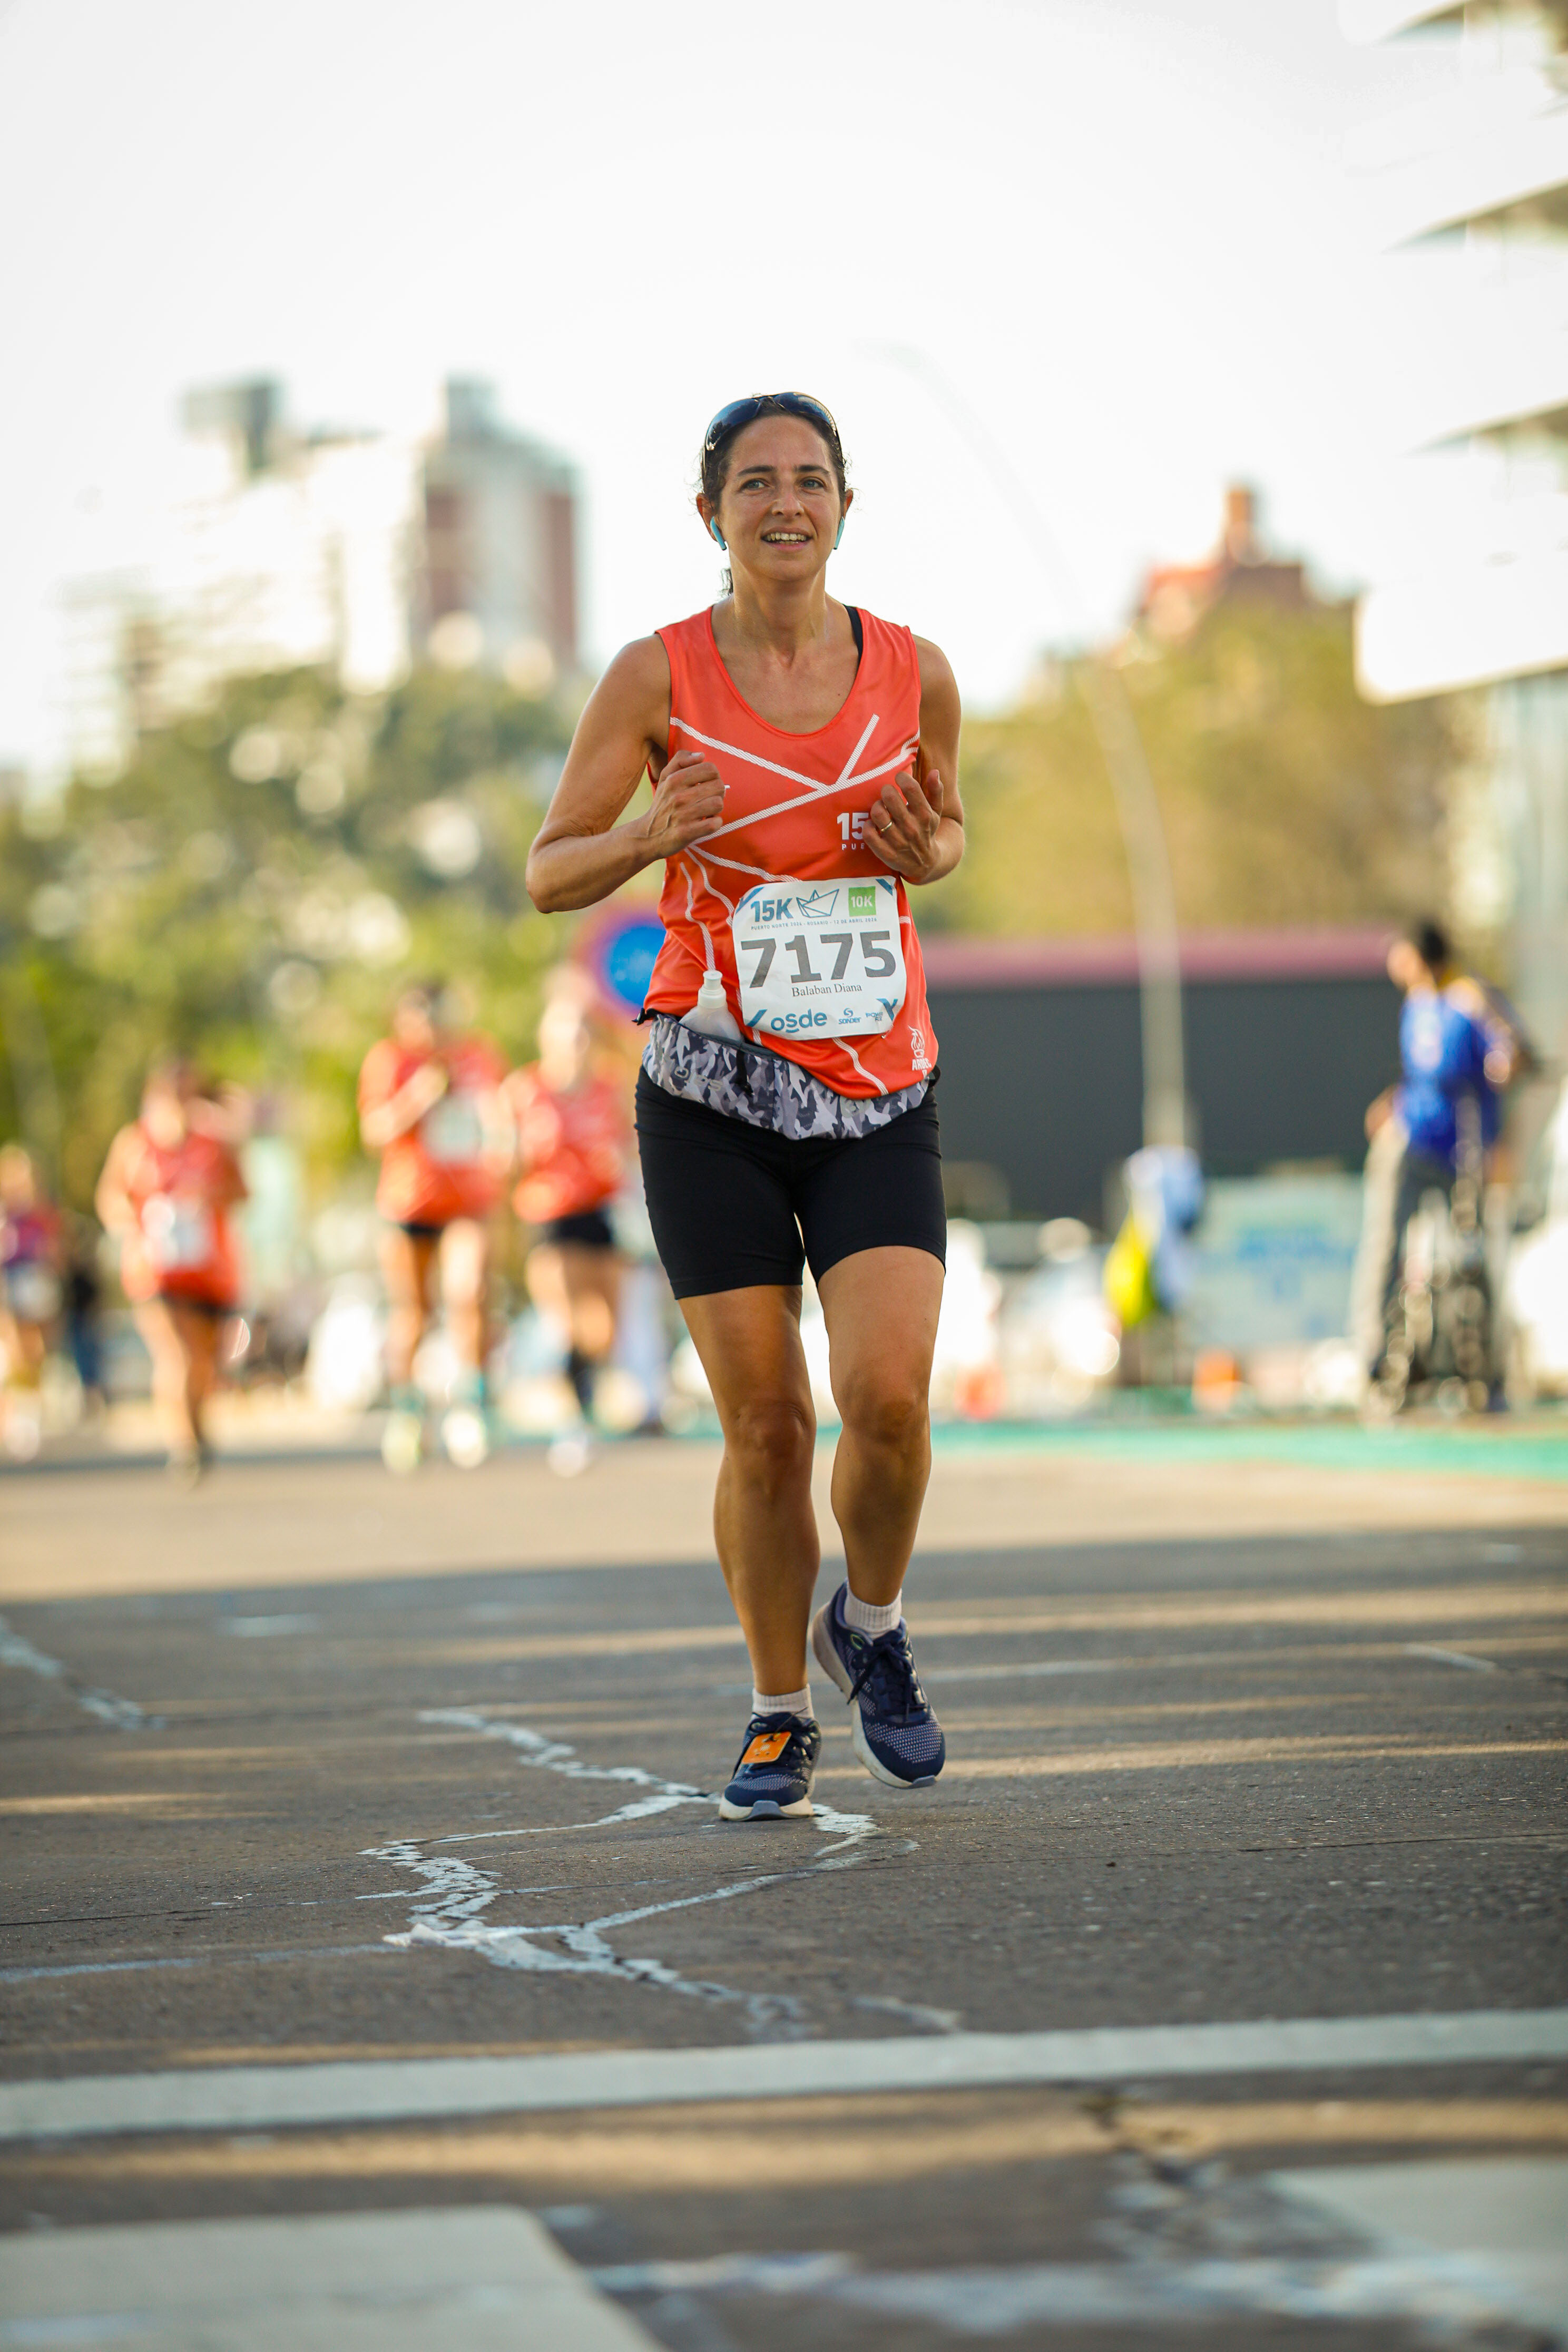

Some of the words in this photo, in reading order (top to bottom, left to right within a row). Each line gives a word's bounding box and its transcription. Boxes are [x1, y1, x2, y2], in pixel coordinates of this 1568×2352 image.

[750, 897, 794, 922] 15K
[850, 895, 873, 908] 10K
[740, 930, 896, 988] 7175
[791, 985, 832, 997] Balaban
[834, 983, 863, 993] Diana
[771, 1008, 827, 1032] osde
